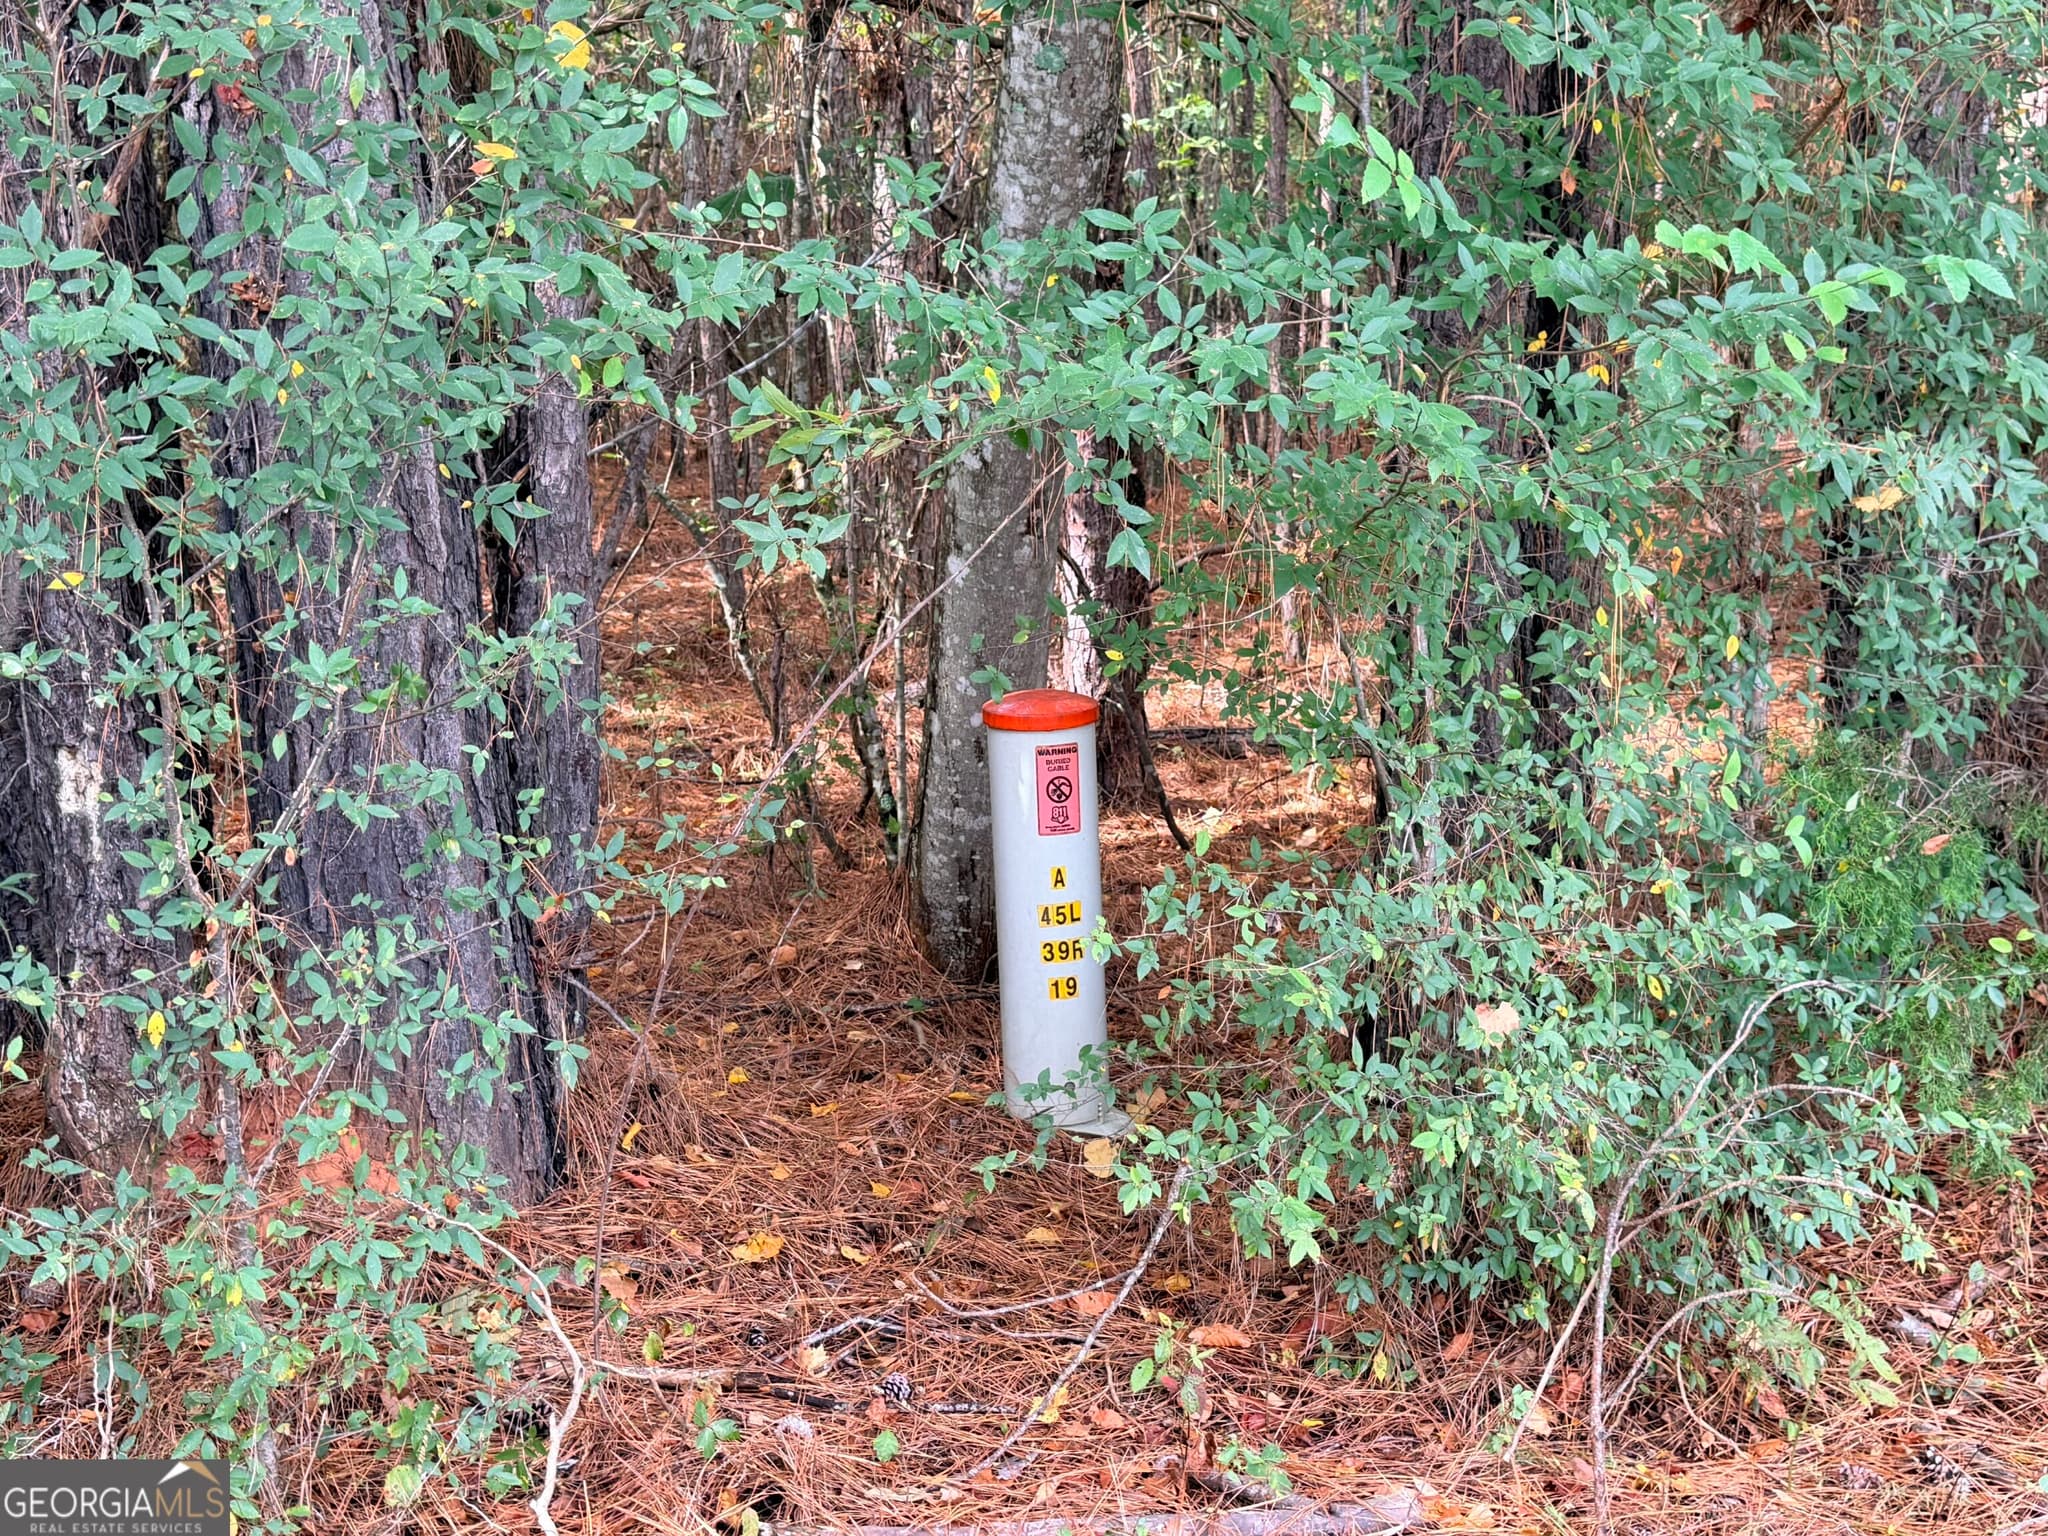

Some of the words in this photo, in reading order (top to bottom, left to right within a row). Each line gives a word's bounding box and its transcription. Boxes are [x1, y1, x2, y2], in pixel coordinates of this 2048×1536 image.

[1037, 746, 1077, 756] WARNING
[1052, 806, 1067, 818] 811
[1053, 868, 1065, 888] A
[1041, 903, 1081, 925] 45L
[1051, 977, 1077, 999] 19
